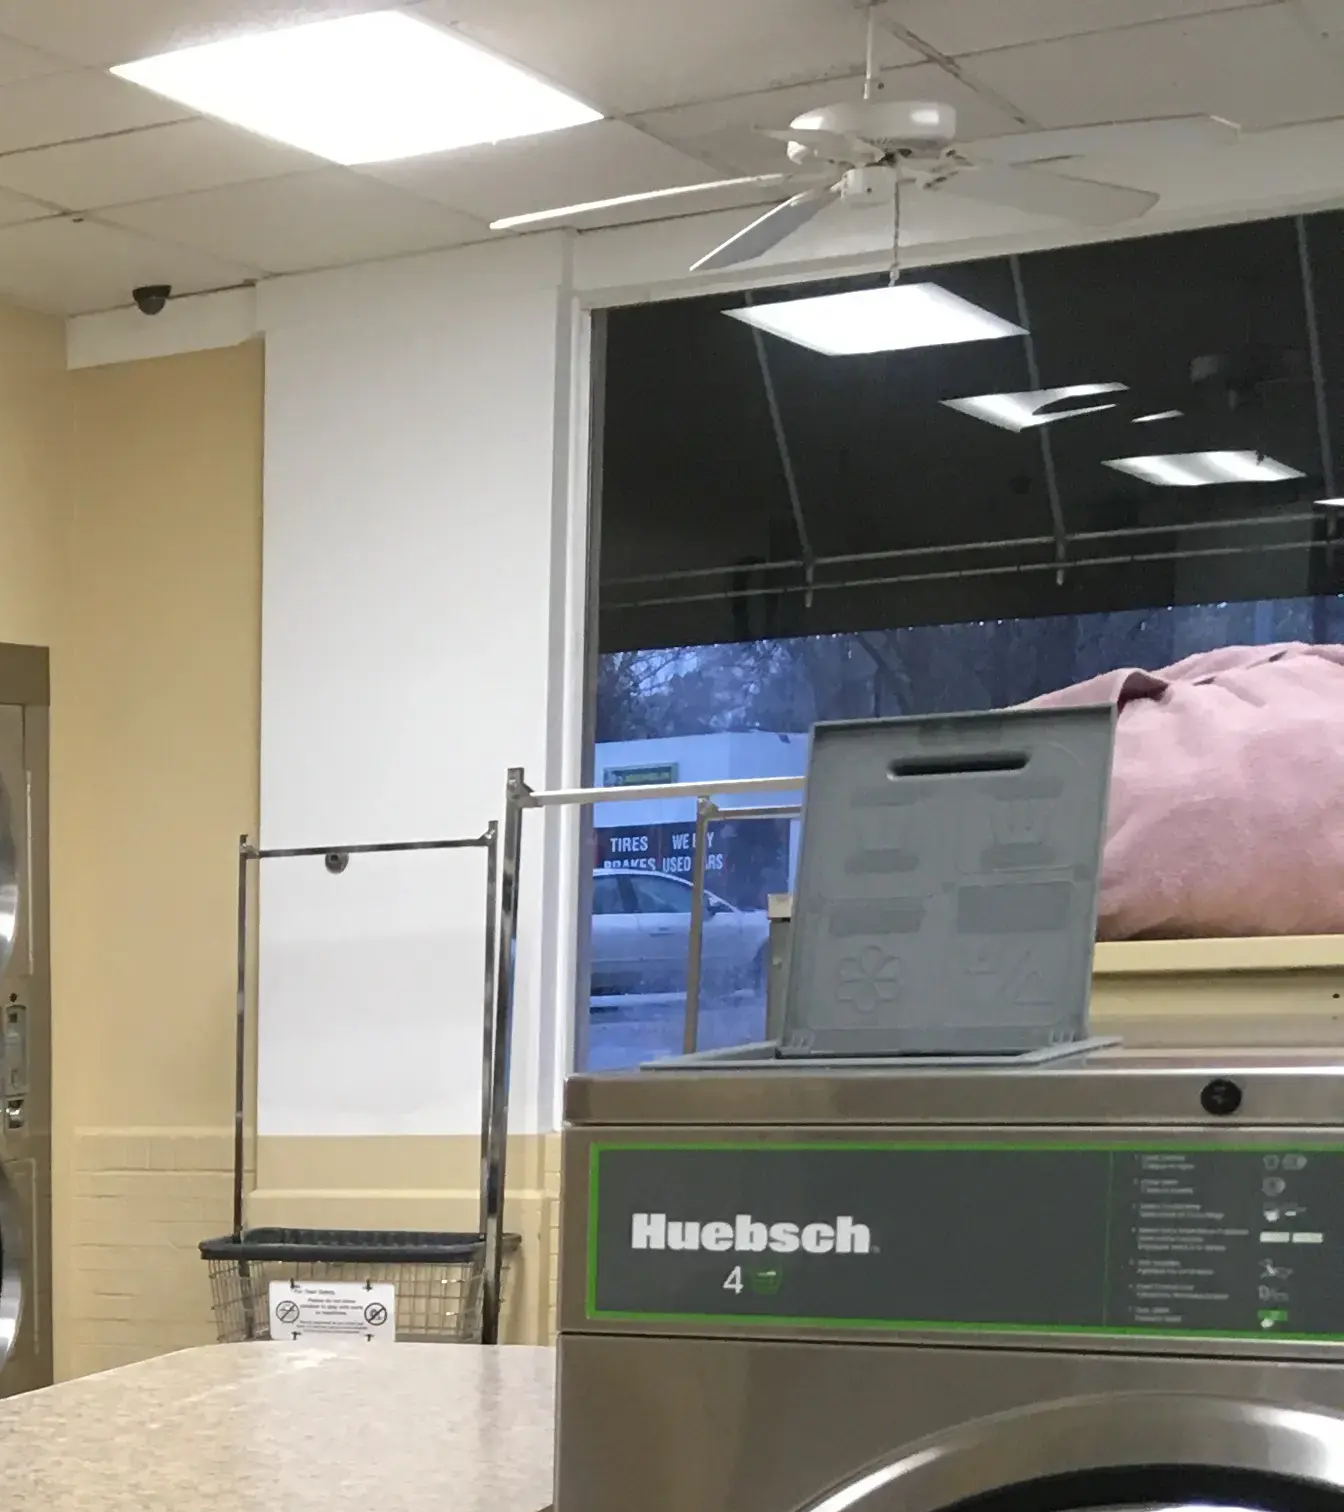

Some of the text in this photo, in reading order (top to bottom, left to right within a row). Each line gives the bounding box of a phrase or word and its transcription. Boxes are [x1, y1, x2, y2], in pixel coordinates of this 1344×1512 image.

[610, 836, 649, 853] TIRES
[671, 833, 690, 850] WE
[662, 856, 691, 873] USED
[631, 1213, 871, 1254] Huebsch
[722, 1265, 744, 1294] 4
